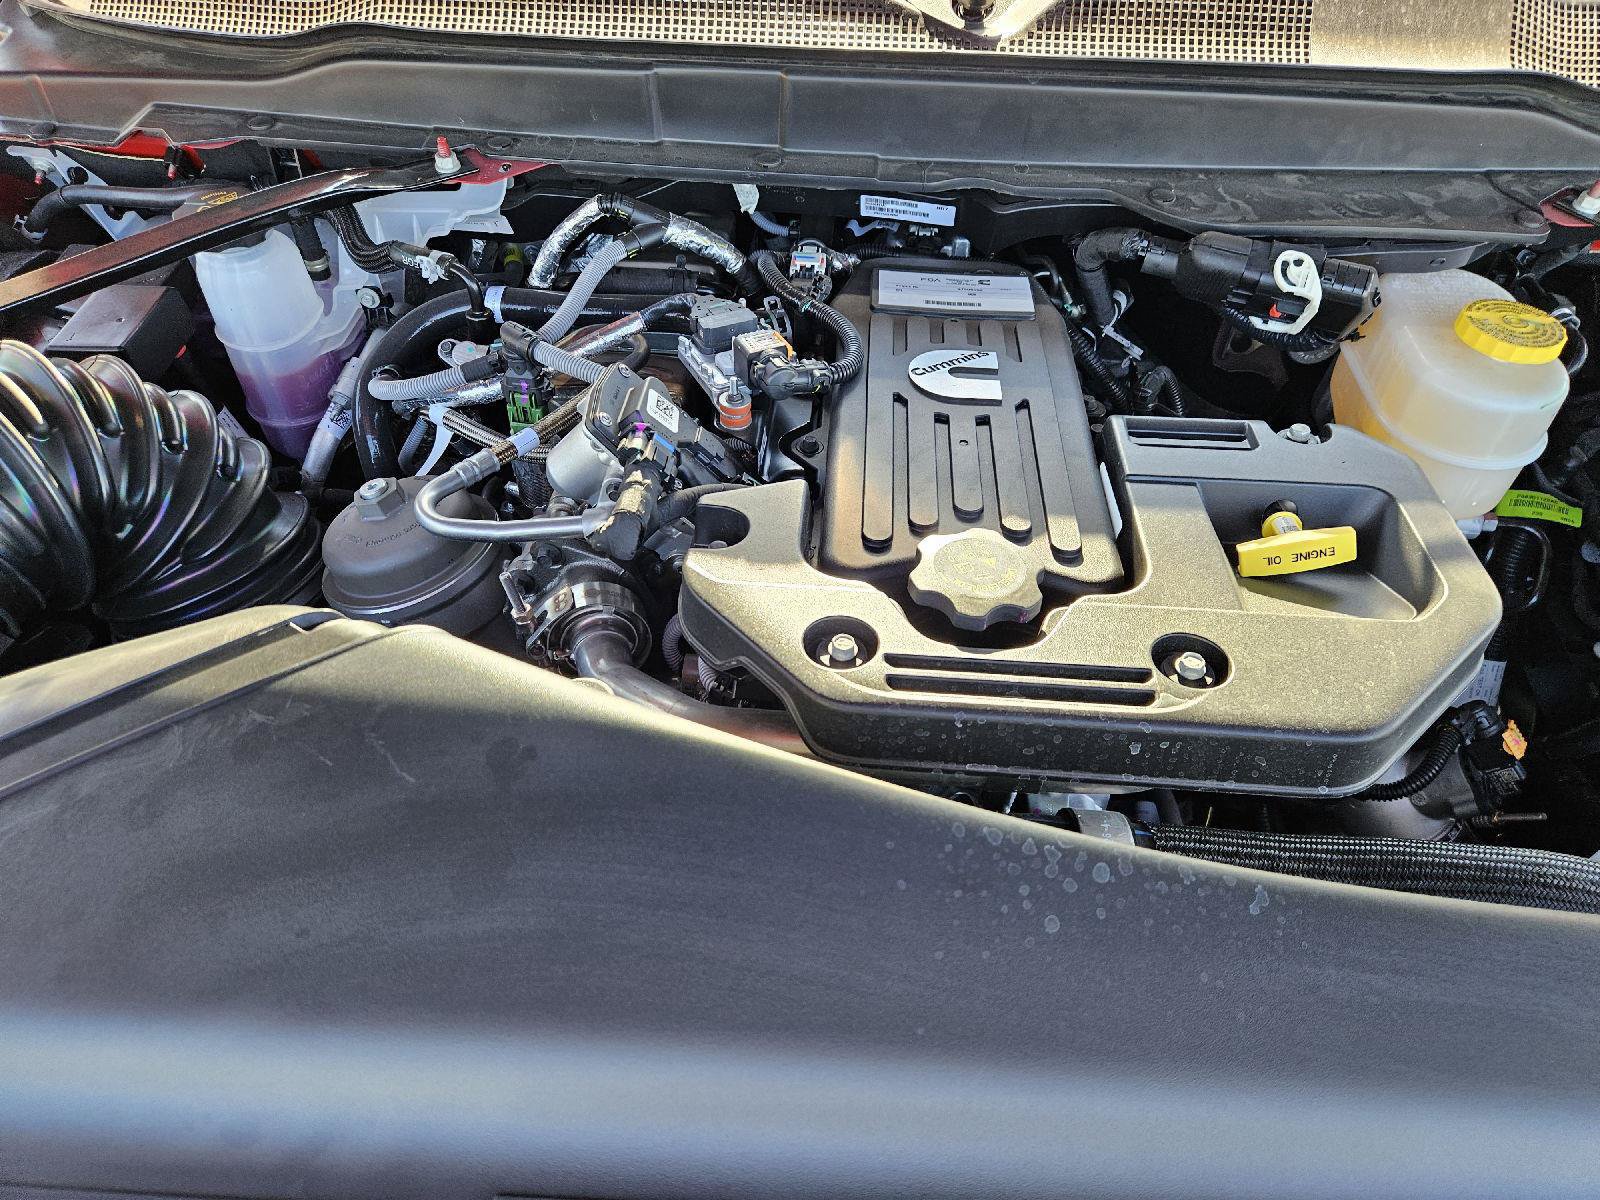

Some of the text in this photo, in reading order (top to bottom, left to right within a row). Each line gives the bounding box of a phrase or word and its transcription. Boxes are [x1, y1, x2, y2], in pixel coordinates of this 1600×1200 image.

[910, 350, 990, 377] Cummins
[1262, 546, 1336, 567] ENGINE OIL
